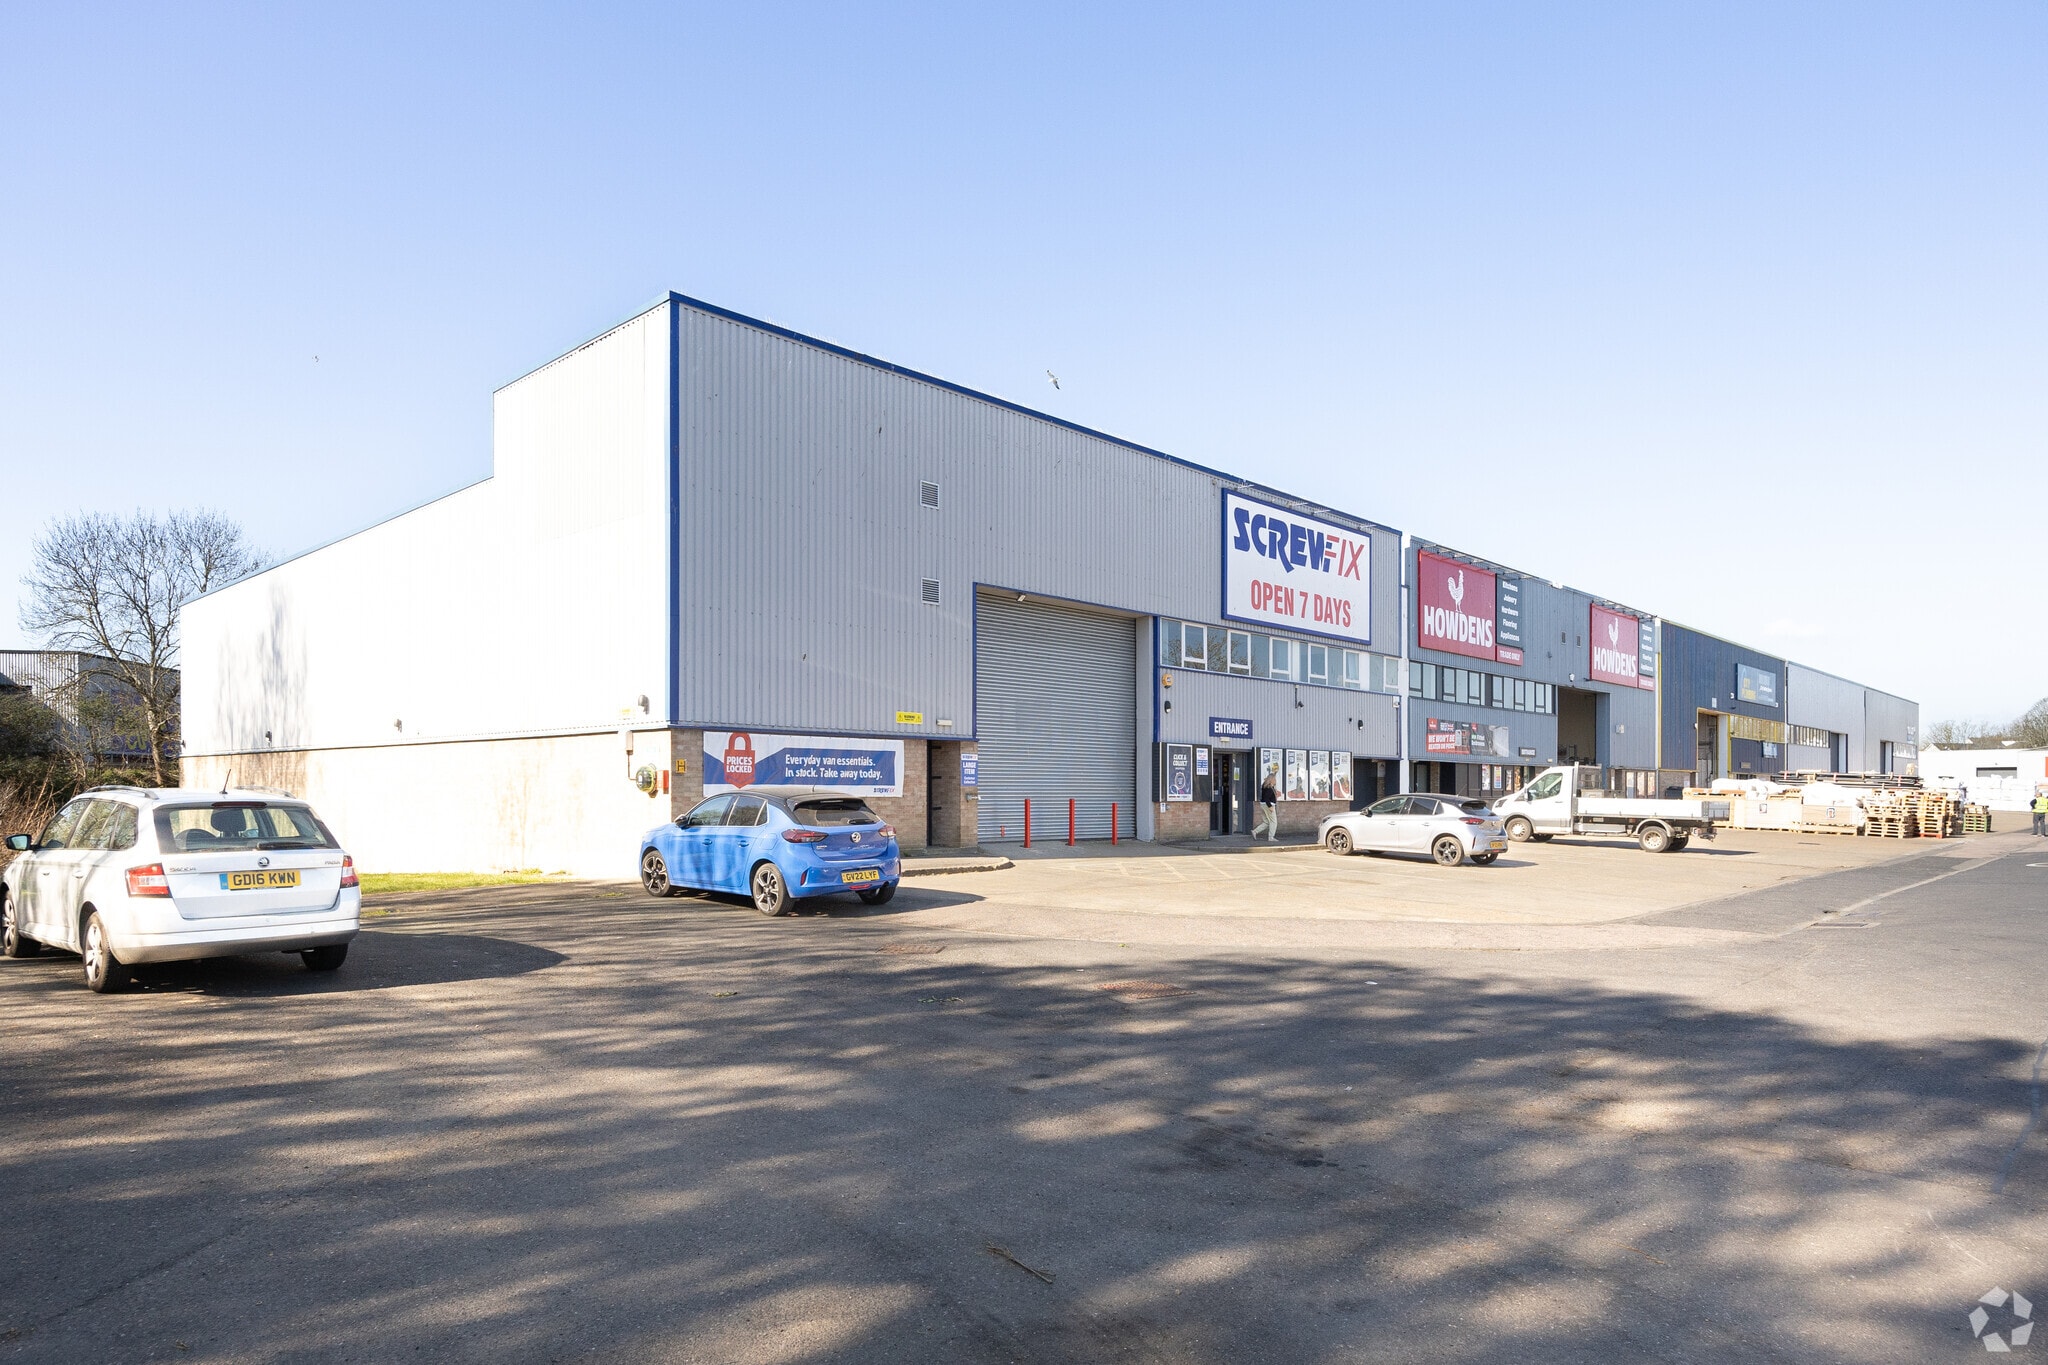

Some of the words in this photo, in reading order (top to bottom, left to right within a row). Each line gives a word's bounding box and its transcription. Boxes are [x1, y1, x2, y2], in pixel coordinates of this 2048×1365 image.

[1233, 507, 1365, 580] SCREWFIX
[1251, 579, 1294, 616] OPEN
[1299, 591, 1309, 619] 7
[1314, 594, 1351, 627] DAYS
[1424, 605, 1493, 648] HOWDENS
[1593, 646, 1636, 678] HOWDENS
[1214, 721, 1249, 735] ENTRANCE
[677, 760, 686, 771] H
[726, 756, 752, 765] PRICES
[785, 754, 821, 767] Everyday
[823, 756, 836, 765] van
[837, 756, 876, 766] essentials.
[726, 765, 752, 773] LOCKED
[785, 768, 794, 777] In
[795, 768, 818, 778] stock.
[820, 768, 838, 778] Take
[840, 770, 858, 780] away
[859, 769, 883, 780] today.
[233, 874, 265, 886] GD16
[268, 872, 296, 884] KWN
[846, 872, 863, 881] GV22
